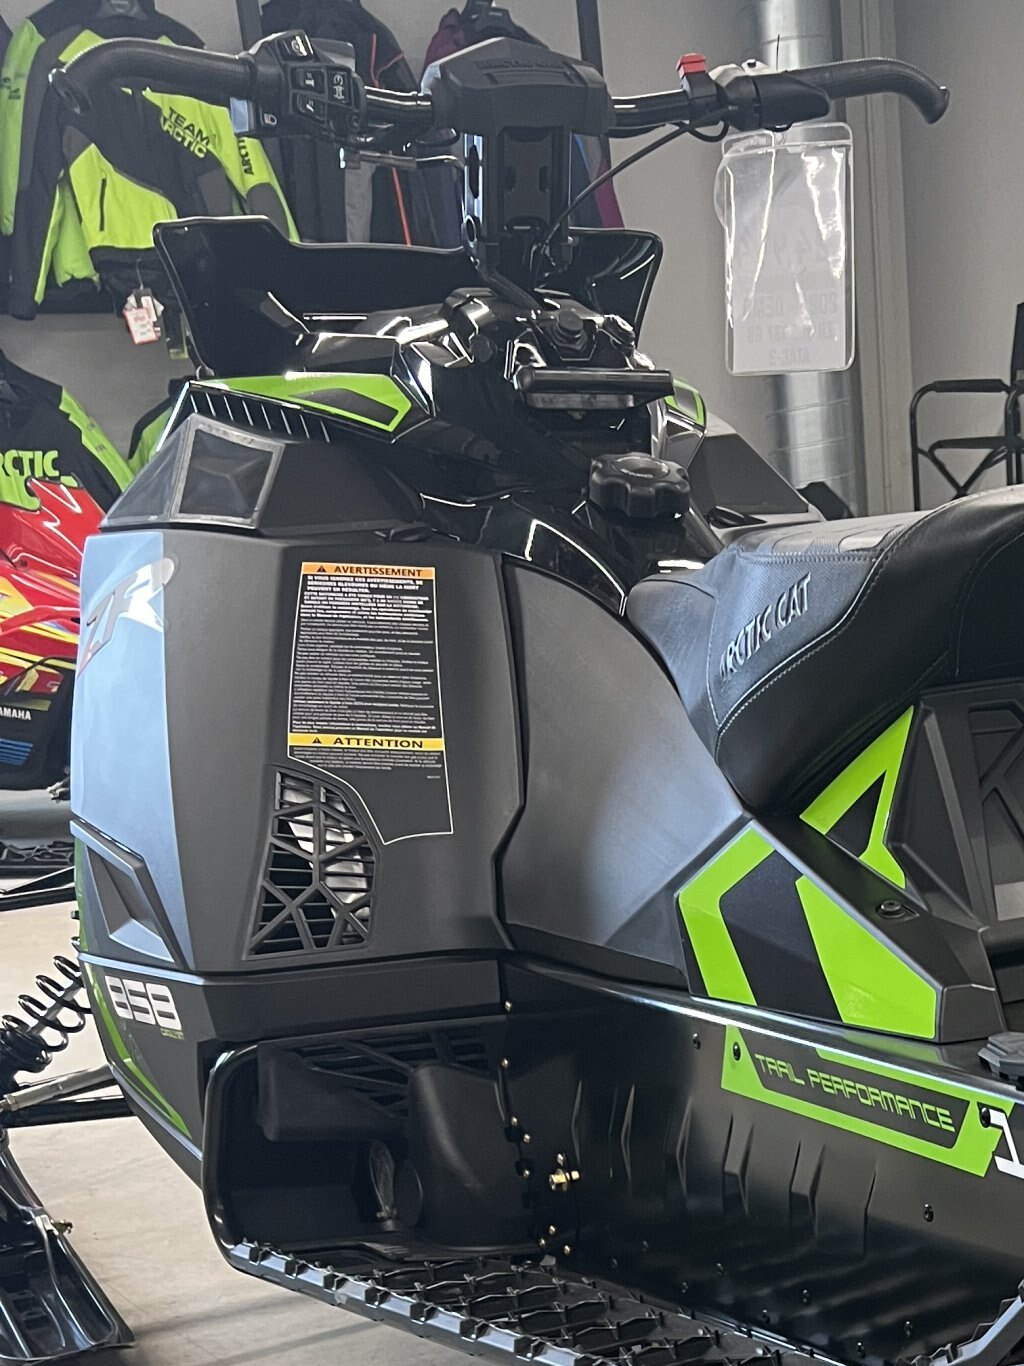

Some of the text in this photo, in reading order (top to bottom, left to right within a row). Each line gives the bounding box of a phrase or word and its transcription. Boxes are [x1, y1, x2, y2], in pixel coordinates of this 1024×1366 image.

[169, 106, 211, 147] TEAM
[334, 565, 423, 578] AVERTISSEMENT
[720, 571, 812, 682] ARCTIC CAT
[333, 737, 424, 749] ATTENTION
[104, 975, 182, 1031] 858
[754, 1053, 956, 1133] TRAIL PERFORMANCE
